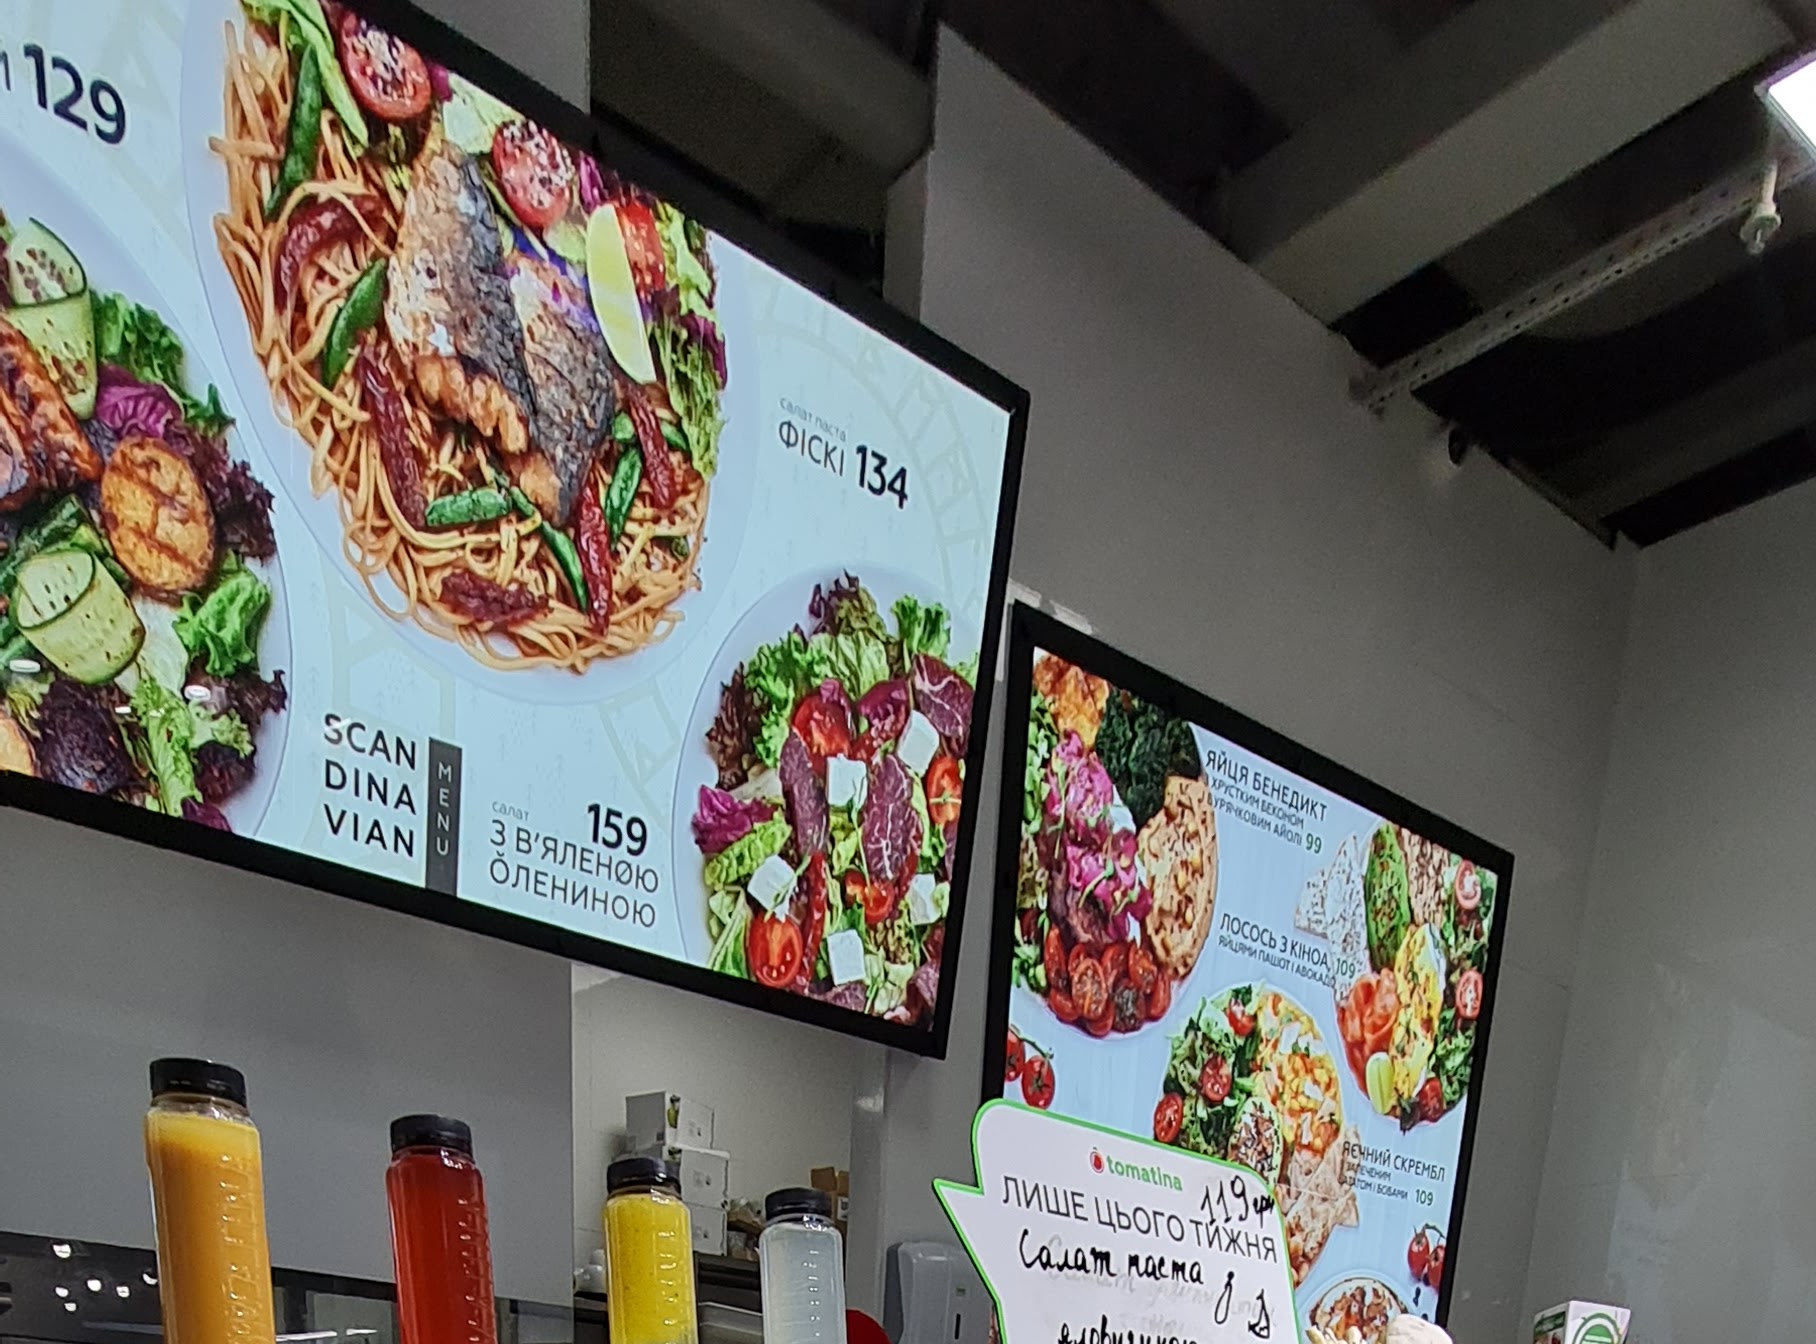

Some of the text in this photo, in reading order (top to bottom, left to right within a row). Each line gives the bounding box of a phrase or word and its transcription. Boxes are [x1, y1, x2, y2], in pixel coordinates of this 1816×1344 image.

[24, 43, 125, 145] 129
[779, 420, 908, 509] ФІСКІ 134
[324, 713, 416, 771] SCAN
[324, 759, 416, 816] DINA
[438, 761, 451, 856] MENU
[492, 801, 530, 821] салат
[1206, 750, 1328, 822] ЯЙЦЯ БЕНЕДИКТ
[324, 803, 414, 858] VIAN
[587, 803, 648, 856] 159
[1306, 833, 1322, 854] 99
[1220, 913, 1277, 949] ЛОСОСЬ
[1335, 959, 1356, 979] 109
[1106, 1154, 1183, 1192] tomatina
[1343, 1141, 1445, 1182] ЯЄЧНИЙ СКРЕМБЛ
[1002, 1175, 1277, 1263] ЛИШЕ ЦЬОГО ТИЖНЯ
[1200, 1175, 1249, 1226] 119
[1415, 1189, 1434, 1206] 109
[1019, 1229, 1118, 1278] Салат
[1127, 1249, 1204, 1285] паста
